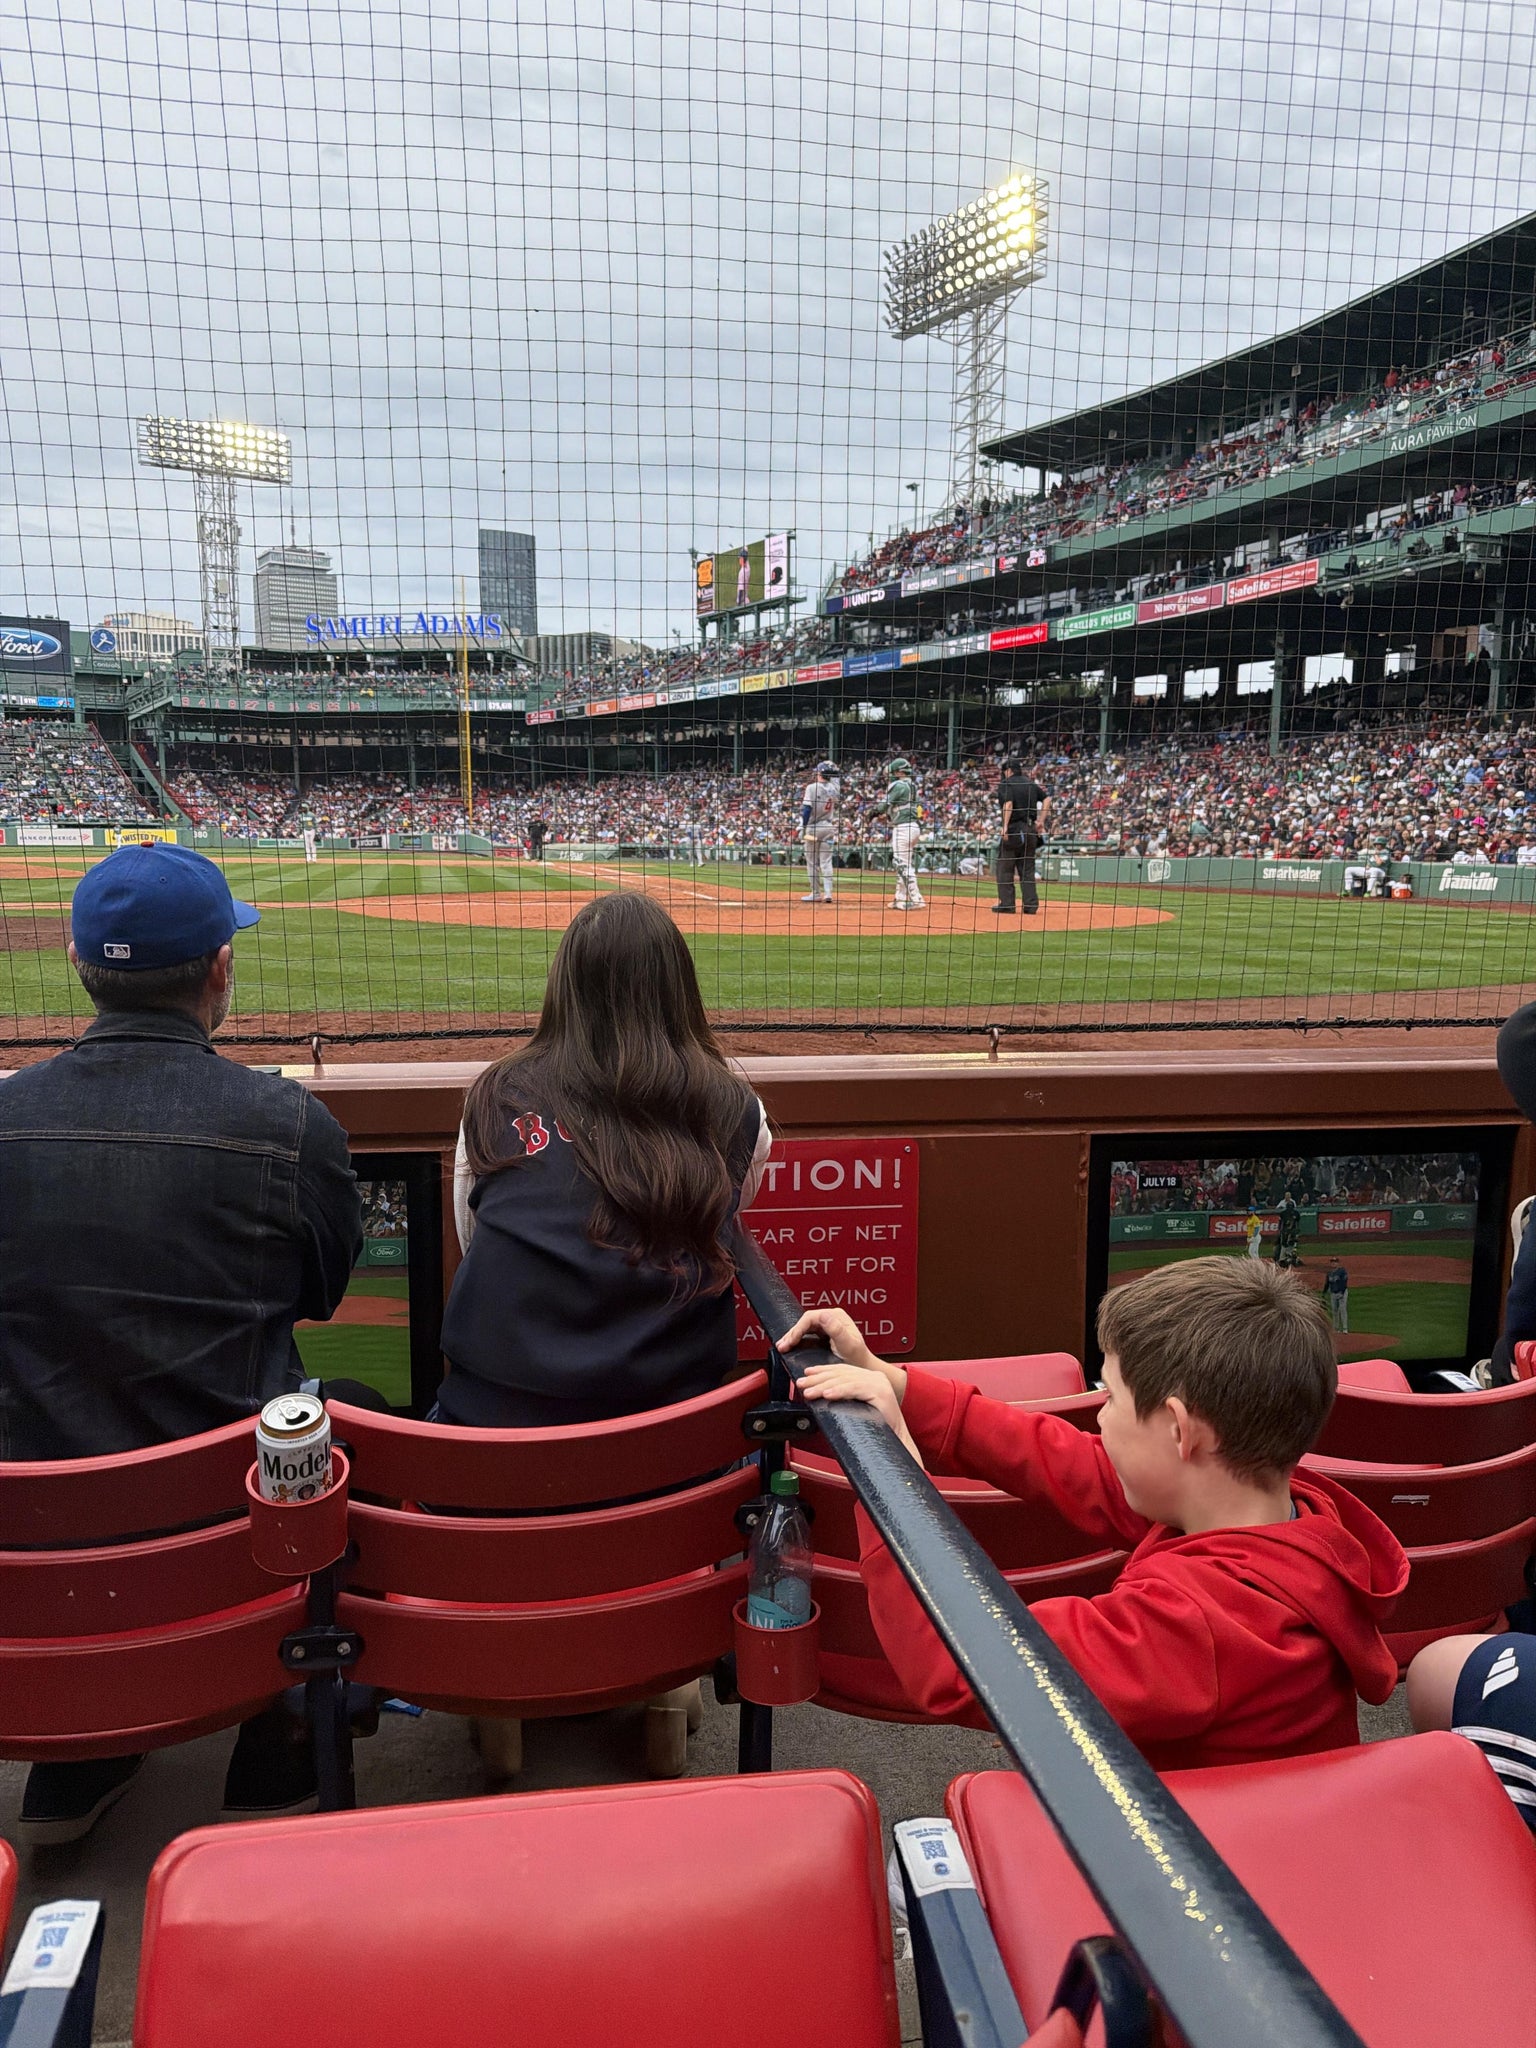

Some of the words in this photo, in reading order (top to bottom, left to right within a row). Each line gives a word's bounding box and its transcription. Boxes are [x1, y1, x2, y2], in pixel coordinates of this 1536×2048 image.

[1426, 413, 1477, 441] PAVILION
[851, 588, 885, 607] UNITED
[1229, 580, 1270, 599] Safelite
[1190, 595, 1207, 606] Nine
[305, 612, 403, 643] SAMUEL
[413, 611, 502, 640] ADAMS
[1069, 617, 1098, 633] GRILLO'S
[1100, 610, 1132, 626] PICKLES
[0, 631, 43, 654] Ford
[245, 701, 259, 710] 27
[1263, 865, 1321, 880] smartwater
[1438, 867, 1499, 892] franklin
[764, 1158, 902, 1192] TION!
[1142, 1177, 1166, 1187] JULY
[1167, 1176, 1177, 1186] 18
[1322, 1217, 1386, 1231] Safelite
[750, 1227, 795, 1244] EAR
[808, 1226, 843, 1243] OF
[855, 1224, 902, 1241] NET
[773, 1258, 834, 1276] LERT
[846, 1256, 896, 1273] FOR
[801, 1288, 888, 1307] EAVING
